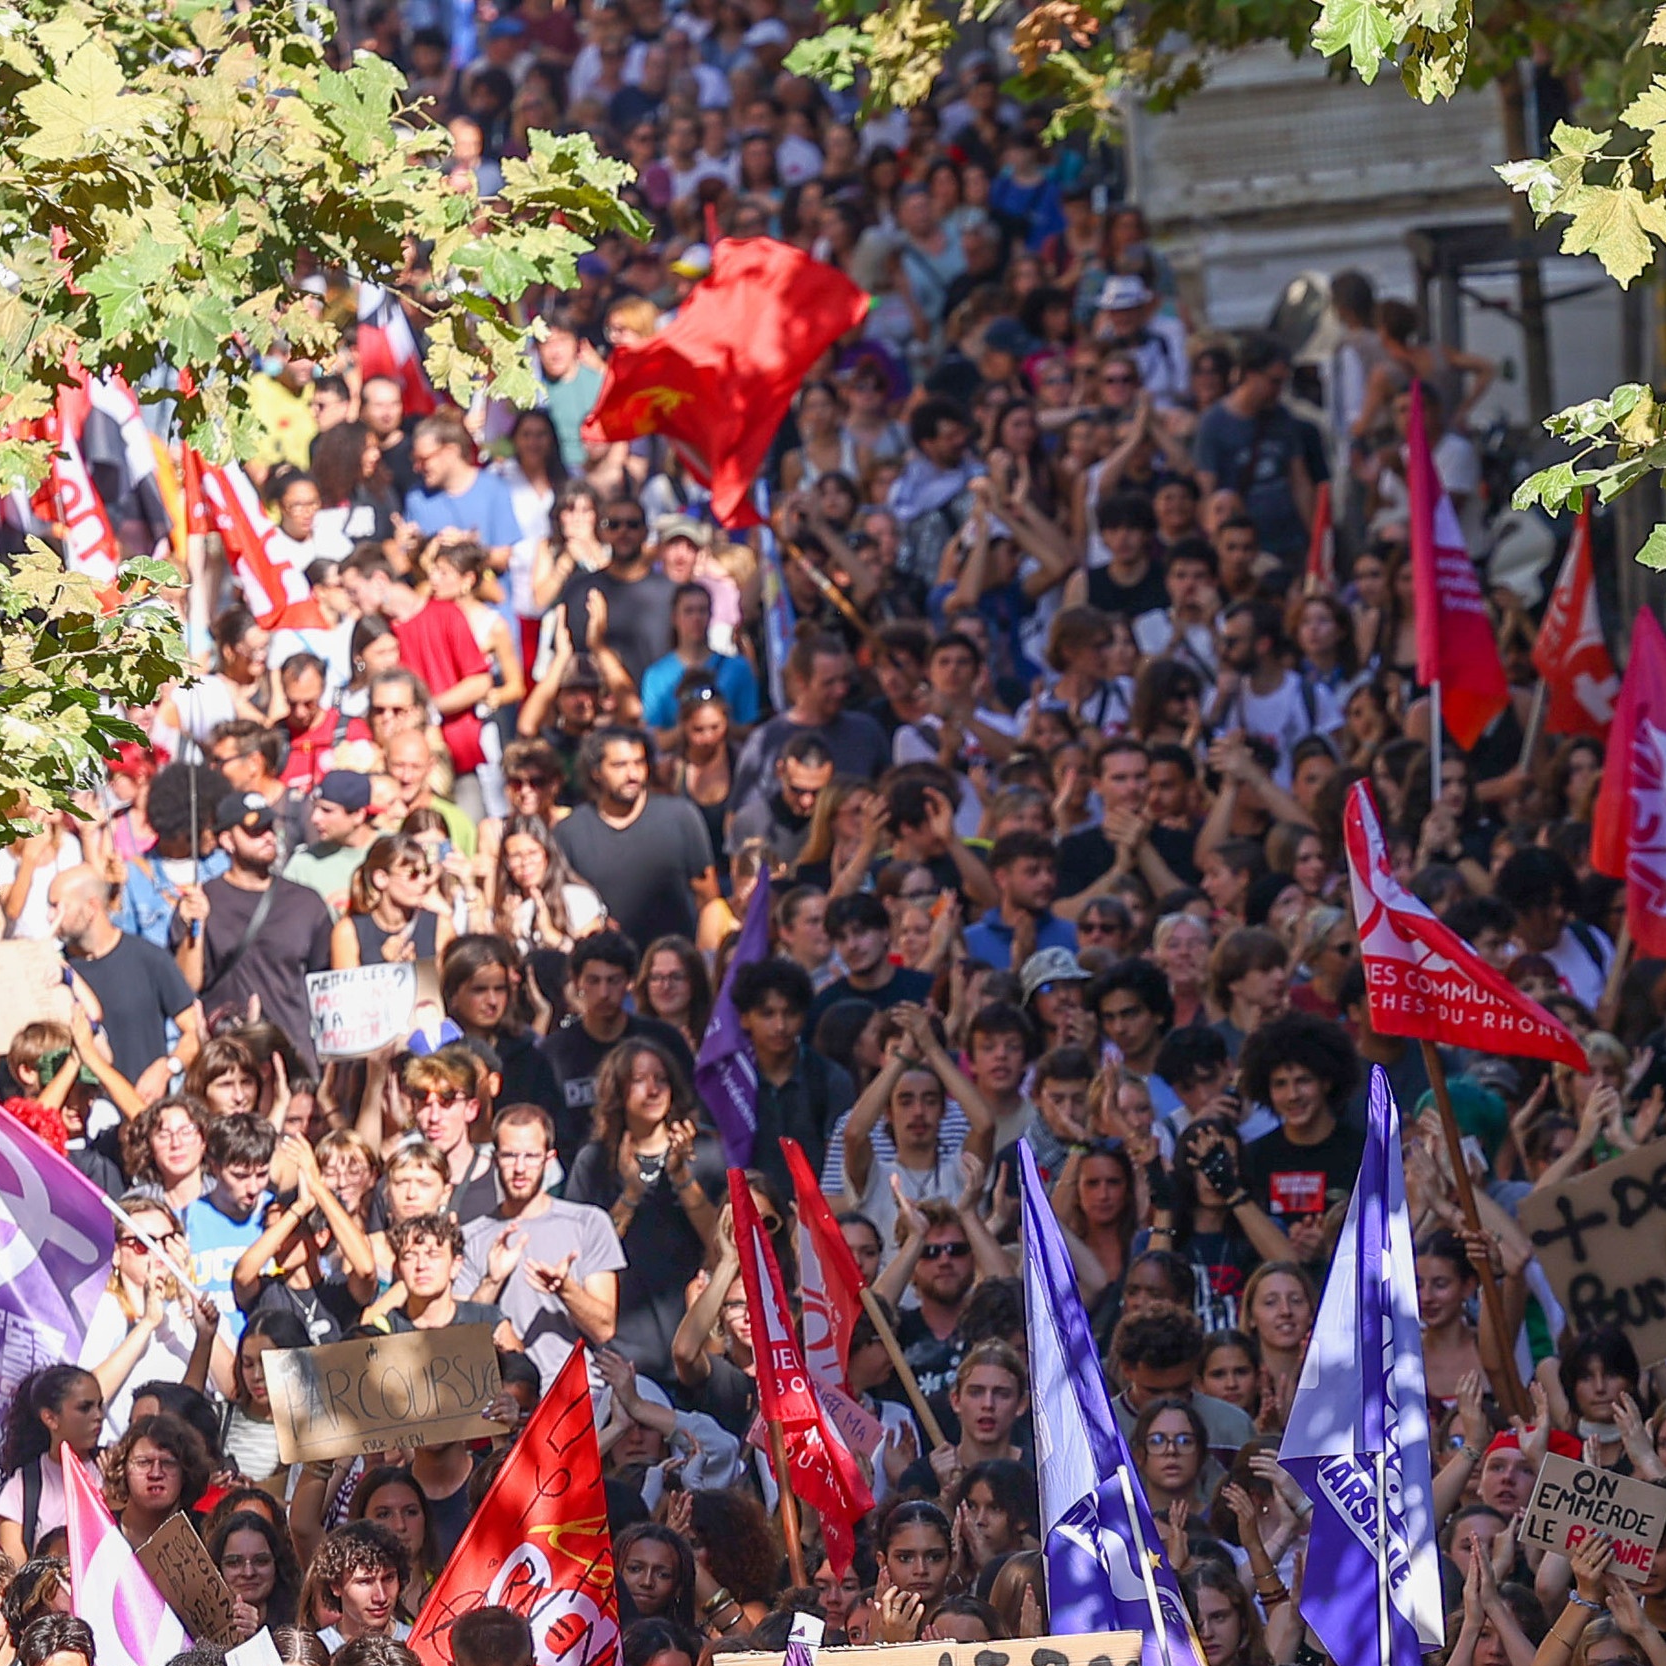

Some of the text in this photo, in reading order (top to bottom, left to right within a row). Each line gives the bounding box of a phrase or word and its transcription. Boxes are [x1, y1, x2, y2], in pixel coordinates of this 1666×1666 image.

[1572, 1469, 1619, 1499] ON
[1537, 1482, 1655, 1538] EMMERDE
[1527, 1514, 1558, 1544] LE
